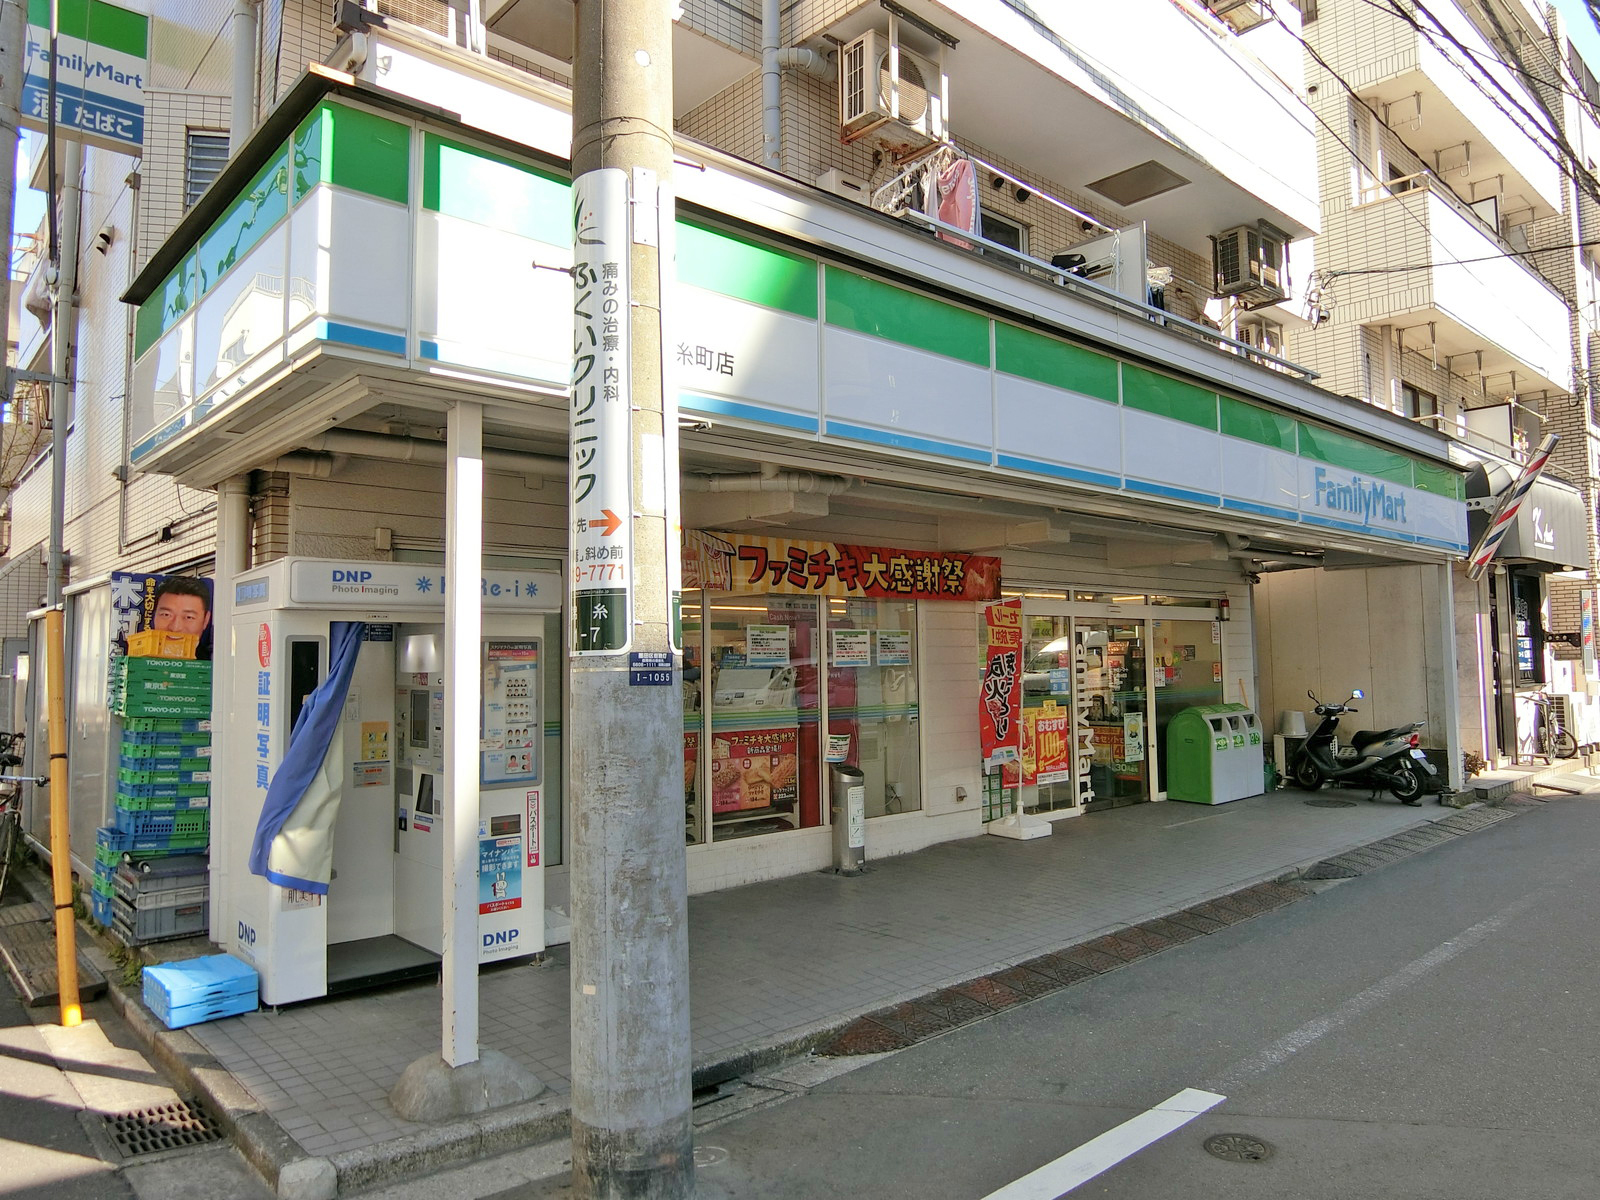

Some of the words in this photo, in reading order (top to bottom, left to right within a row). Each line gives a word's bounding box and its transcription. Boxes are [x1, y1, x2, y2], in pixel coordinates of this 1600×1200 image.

[27, 40, 143, 89] FamilyMart
[32, 90, 64, 124] 酒
[75, 106, 134, 139] たばこ
[602, 262, 619, 403] 痛みの治療・内科
[676, 342, 735, 377] 糸町店
[573, 262, 599, 503] ふくいクリニック
[1314, 466, 1407, 527] FamilyMart
[332, 570, 372, 583] DNP
[738, 544, 965, 597] ファミチキ大感謝祭
[332, 584, 360, 593] Photo
[361, 585, 399, 595] Imaging
[592, 602, 608, 620] 糸
[145, 659, 183, 667] TOKYO-DO
[256, 671, 271, 791] 証明写真
[481, 849, 520, 858] マイナンバー
[238, 920, 256, 947] DNP
[483, 928, 520, 947] DNP
